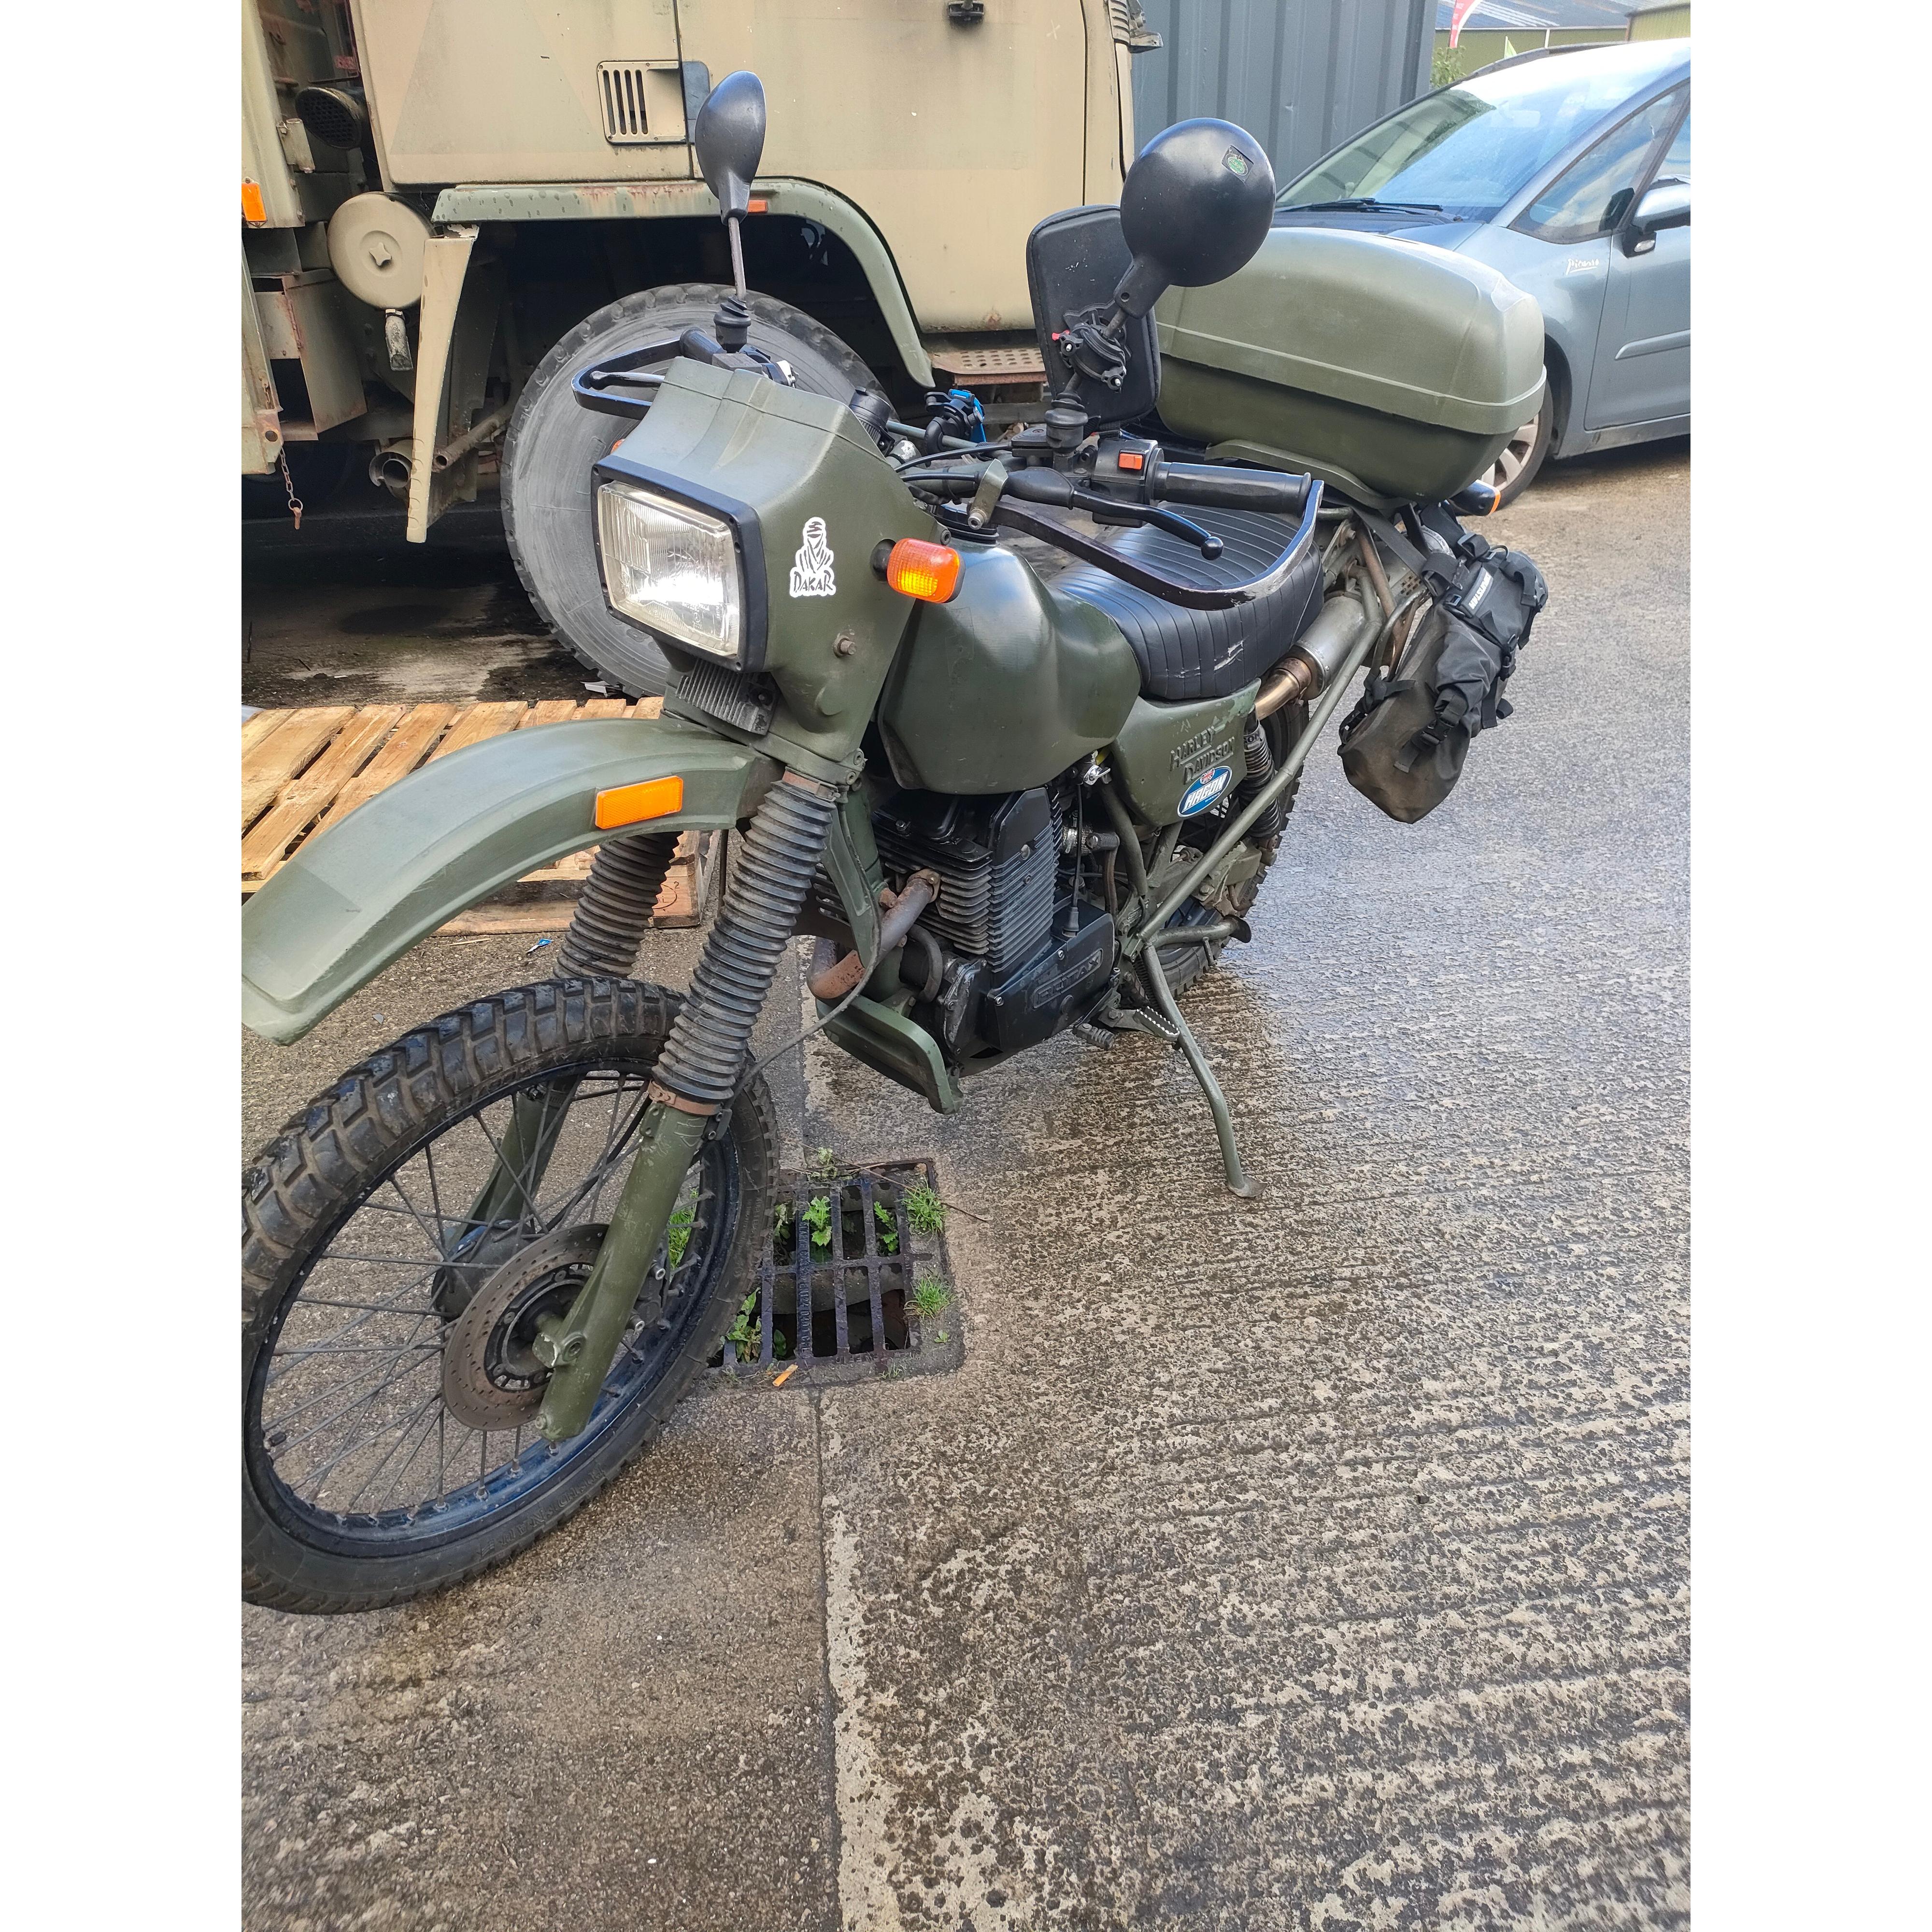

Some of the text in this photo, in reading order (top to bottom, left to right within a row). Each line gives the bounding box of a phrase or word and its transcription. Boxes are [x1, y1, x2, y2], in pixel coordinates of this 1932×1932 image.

[794, 570, 833, 593] DAKAR
[1170, 725, 1215, 771] HARLEY
[1183, 736, 1235, 785] DAVIDSON
[1185, 771, 1228, 810] HAGON
[1037, 955, 1099, 1003] ROTAX
